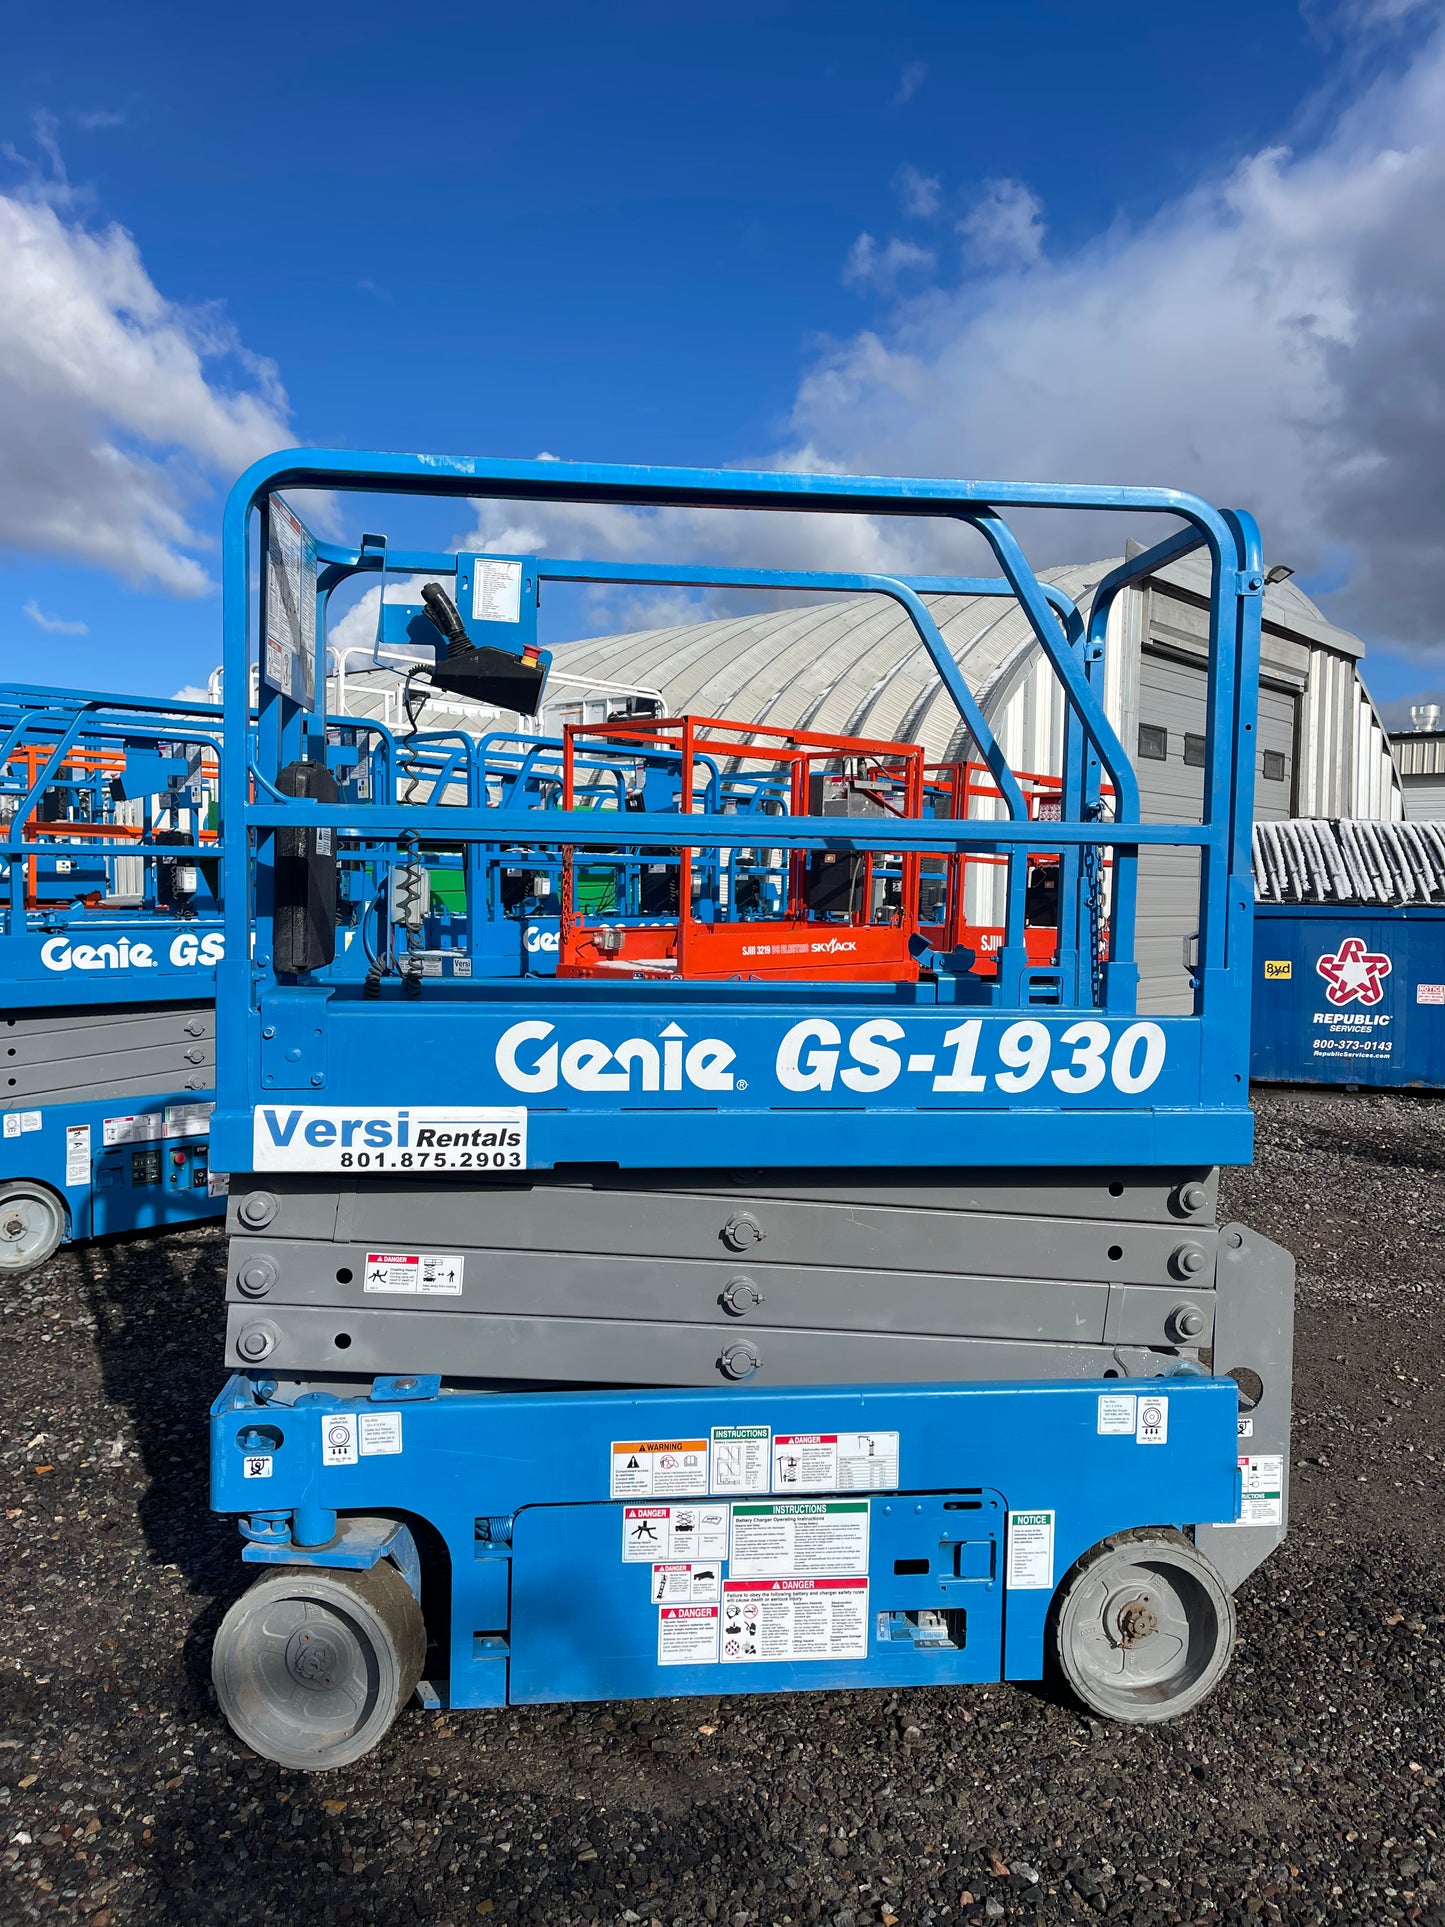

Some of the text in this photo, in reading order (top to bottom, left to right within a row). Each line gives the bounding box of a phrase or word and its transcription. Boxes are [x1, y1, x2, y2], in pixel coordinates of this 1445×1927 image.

[41, 932, 224, 971] Genie GS
[757, 945, 770, 955] 3219
[811, 938, 856, 953] SKYJACK
[1313, 1013, 1390, 1025] REPUBLIC
[1313, 1040, 1392, 1051] 800-373-0143
[495, 1020, 737, 1094] Genie
[775, 1018, 1167, 1094] GS-1930
[1314, 1050, 1390, 1059] RepublicServices.com
[263, 1110, 410, 1148] Versi
[416, 1128, 521, 1147] Rentals
[340, 1152, 521, 1168] 801.875.2903
[647, 1443, 683, 1451] WARNING
[772, 1504, 827, 1514] INSTRUCTIONS
[1018, 1516, 1046, 1524] NOTICE
[782, 1581, 814, 1589] DANGER
[678, 1608, 712, 1617] DANGER
